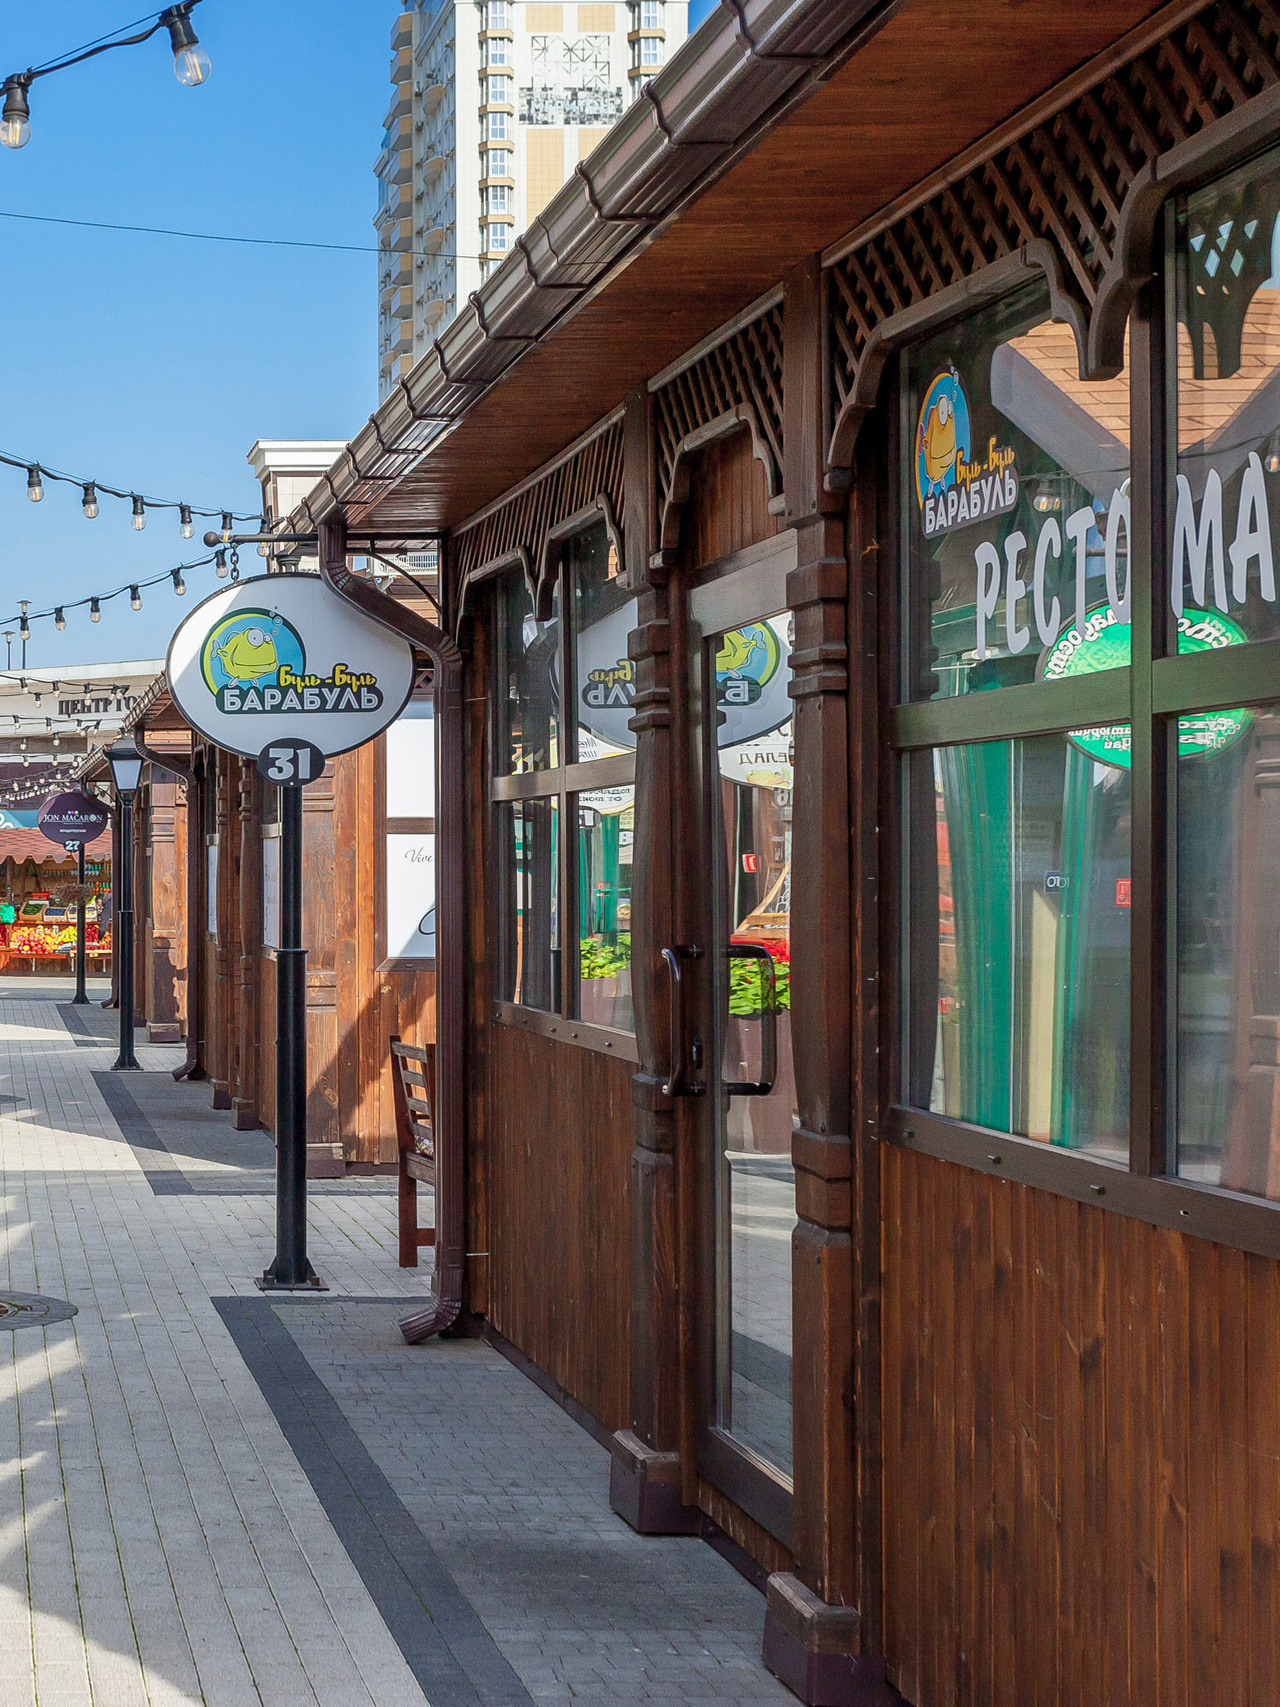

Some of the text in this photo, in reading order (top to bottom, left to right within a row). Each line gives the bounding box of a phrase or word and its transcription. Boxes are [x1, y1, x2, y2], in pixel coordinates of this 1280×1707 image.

[925, 470, 1017, 534] БАРАБУЛЬ
[58, 698, 112, 718] ЦЕНТР
[224, 687, 379, 711] БАРАБУЛЬ
[267, 747, 311, 780] 31
[65, 840, 80, 851] 27
